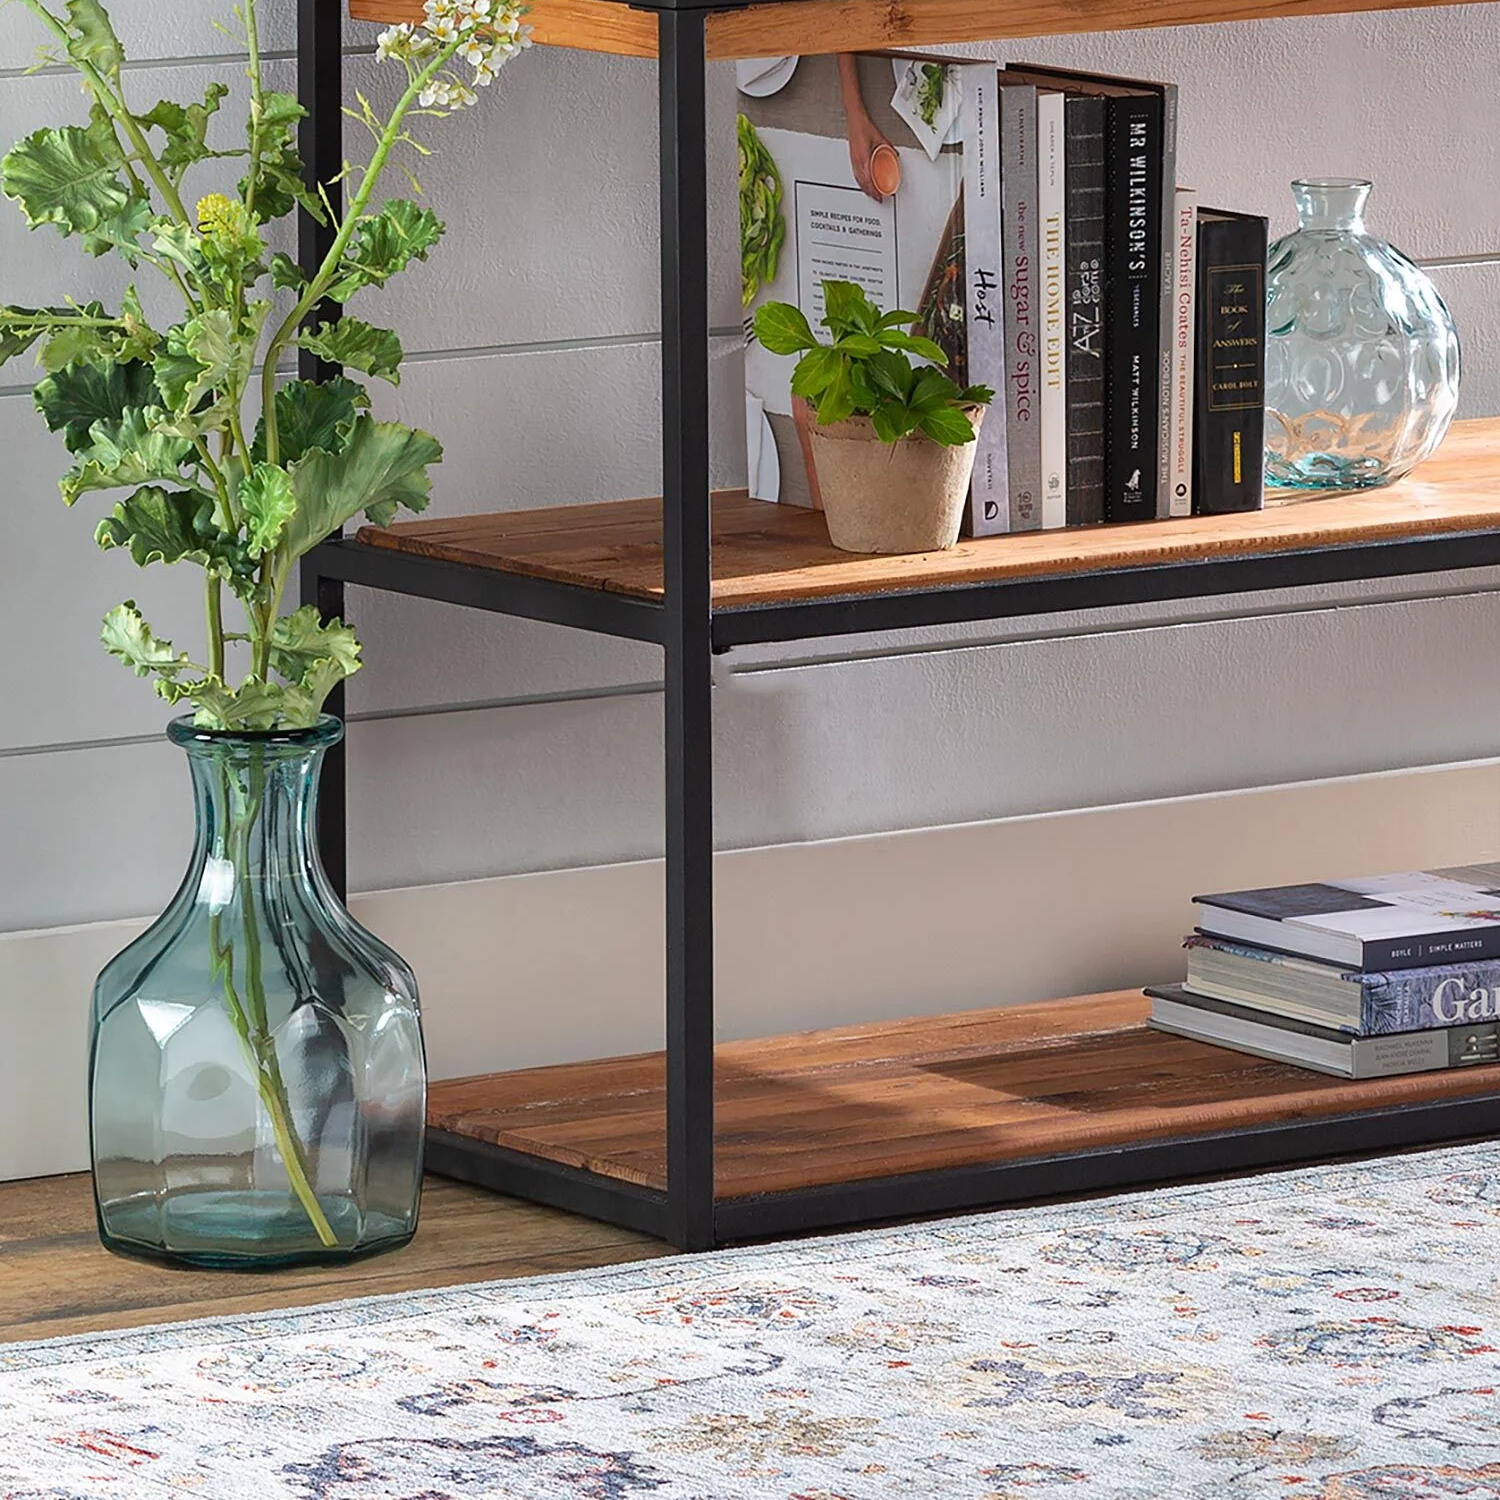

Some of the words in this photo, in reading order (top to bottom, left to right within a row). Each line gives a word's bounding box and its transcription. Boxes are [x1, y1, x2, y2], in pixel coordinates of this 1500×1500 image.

[1129, 123, 1147, 148] MR
[810, 210, 828, 219] SIMPLE
[830, 212, 851, 222] RECIPES
[852, 215, 863, 223] FOR
[1017, 201, 1027, 222] the
[1128, 155, 1147, 270] WILKINSON'S
[811, 222, 840, 233] COCKTAILS
[848, 227, 882, 238] GATHERINGS
[1017, 225, 1026, 251] new
[1046, 212, 1060, 260] THE
[1179, 207, 1193, 288] Ta-Nehisi
[1010, 256, 1030, 326] sugar
[1164, 252, 1173, 295] TEACHER
[1224, 284, 1245, 294] The
[974, 268, 998, 330] Host
[1047, 266, 1060, 332] HOME
[1220, 305, 1249, 315] BOOK
[1178, 292, 1191, 349] Coates
[1227, 320, 1242, 332] of
[1016, 331, 1036, 357] &
[1212, 337, 1258, 348] ANSWERS
[1047, 338, 1061, 390] EDIT
[1131, 355, 1140, 384] MATT
[1161, 350, 1171, 408] NOTEBOOK
[1179, 355, 1187, 372] THE
[1012, 362, 1036, 422] spice
[1178, 375, 1186, 424] BEAUTIFUL
[1212, 382, 1237, 391] CAROL
[1238, 380, 1259, 389] BOLT
[1130, 388, 1140, 450] WILKINSON
[1160, 408, 1171, 464] MUSICIAN'S
[1177, 426, 1186, 474] STRUGGLE
[1160, 465, 1169, 484] THE
[1391, 948, 1412, 958] BOYLE
[1428, 943, 1453, 954] SIMPLE
[1454, 940, 1483, 950] MATTERS
